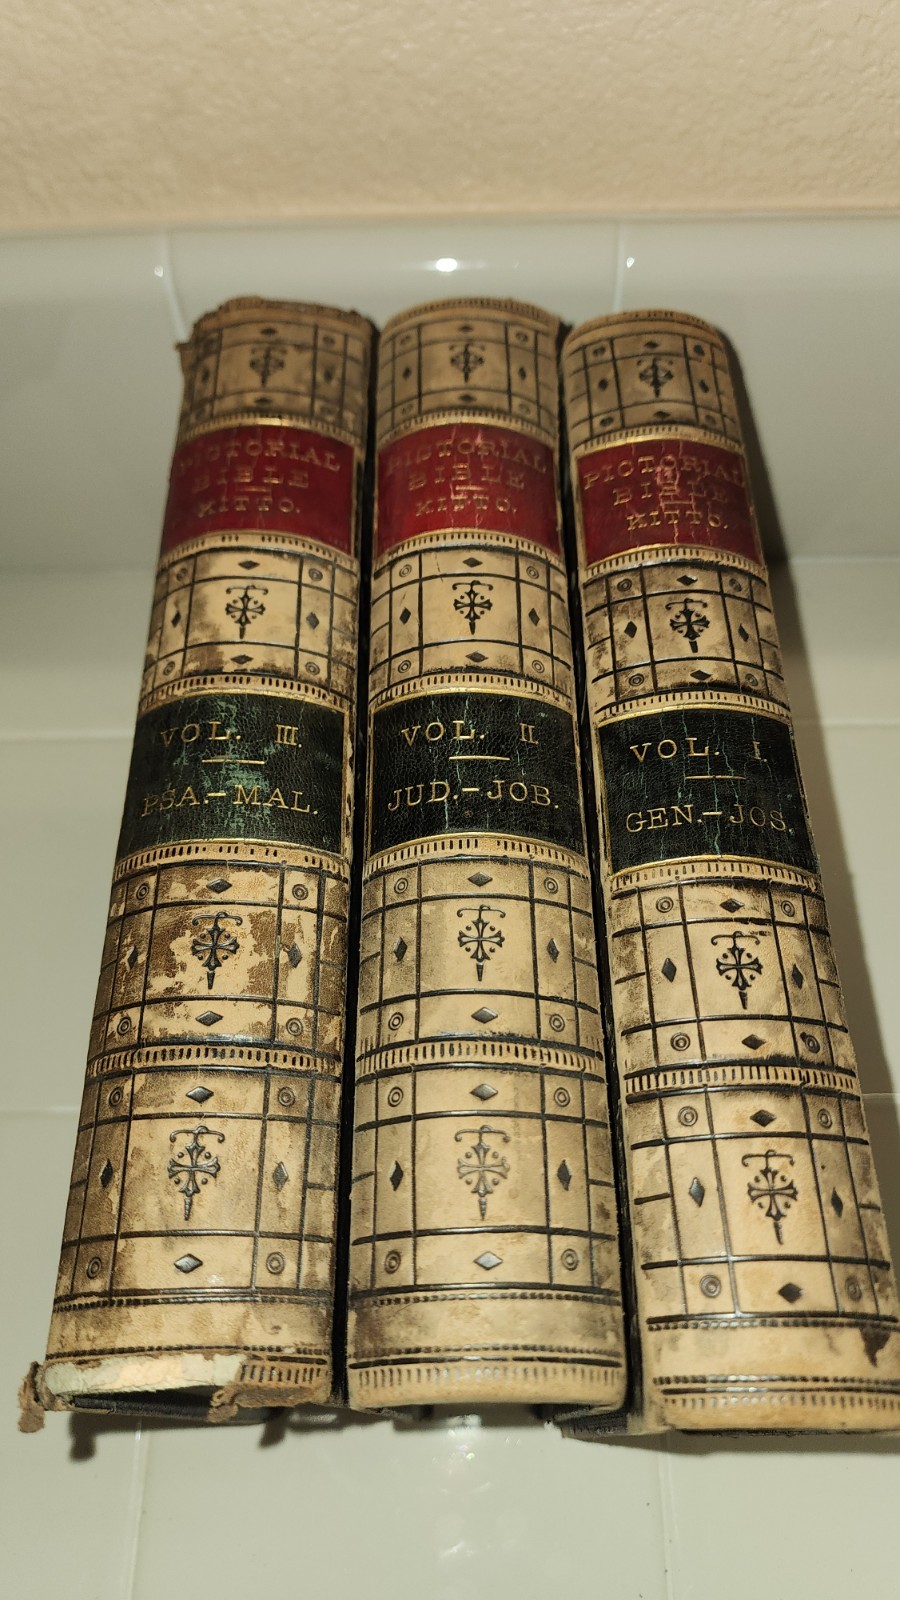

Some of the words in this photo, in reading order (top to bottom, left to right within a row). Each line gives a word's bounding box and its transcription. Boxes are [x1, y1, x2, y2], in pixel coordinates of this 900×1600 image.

[192, 463, 309, 493] BIBLE
[409, 463, 524, 492] BIBLE
[197, 495, 301, 518] KITTO.
[416, 494, 518, 517] KITTO.
[612, 480, 728, 507] BIBLE
[626, 509, 729, 531] KITTO.
[160, 721, 242, 747] VOL.
[275, 724, 303, 748] III.
[401, 720, 486, 747] VOL.
[629, 737, 721, 762] VOL.
[752, 741, 768, 762] I.
